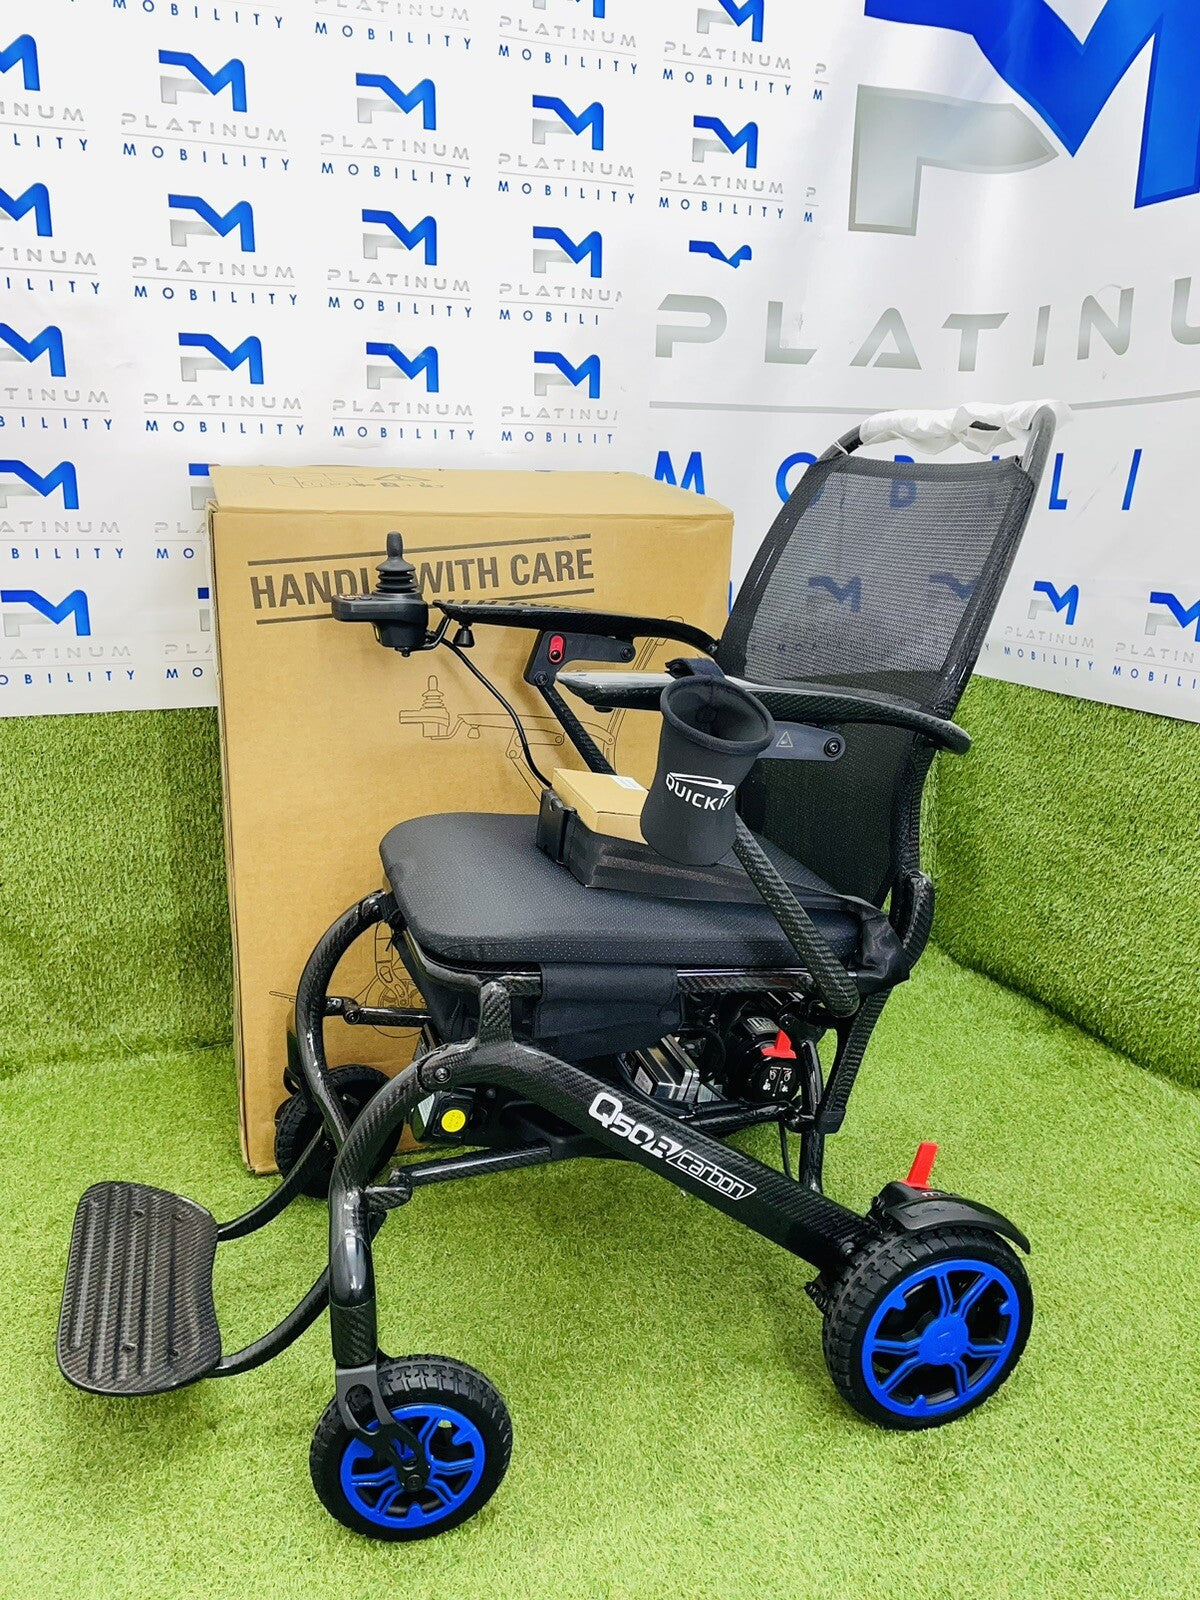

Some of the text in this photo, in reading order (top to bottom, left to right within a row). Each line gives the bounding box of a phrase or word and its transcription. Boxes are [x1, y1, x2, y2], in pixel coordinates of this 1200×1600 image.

[315, 22, 471, 50] MOBILITY
[500, 16, 636, 48] PLATINUM
[499, 45, 637, 74] MOBILITY
[664, 41, 791, 70] PLATINUM
[663, 68, 792, 96] MOBILITY
[121, 112, 287, 142] PLATINUM
[123, 143, 290, 171] MOBILITY
[321, 133, 469, 160] PLATINUM
[321, 163, 471, 188] MOBILITY
[499, 153, 634, 179] PLATINUM
[498, 181, 634, 204] MOBILITY
[660, 171, 784, 194] PLATINUM
[659, 197, 784, 219] MOBILITY
[132, 256, 295, 278] PLATINUM
[327, 269, 470, 292] PLATINUM
[134, 285, 297, 306] MOBILITY
[329, 297, 471, 318] MOBILITY
[143, 393, 302, 410] PLATINUM
[333, 400, 472, 416] PLATINUM
[145, 420, 304, 436] MOBILITY
[333, 426, 474, 440] MOBILITY
[417, 556, 499, 594] WITH
[510, 548, 594, 586] CARE
[1004, 626, 1094, 649] PLATINUM
[1004, 646, 1094, 671] MOBILITY
[676, 1153, 745, 1198] carbon
